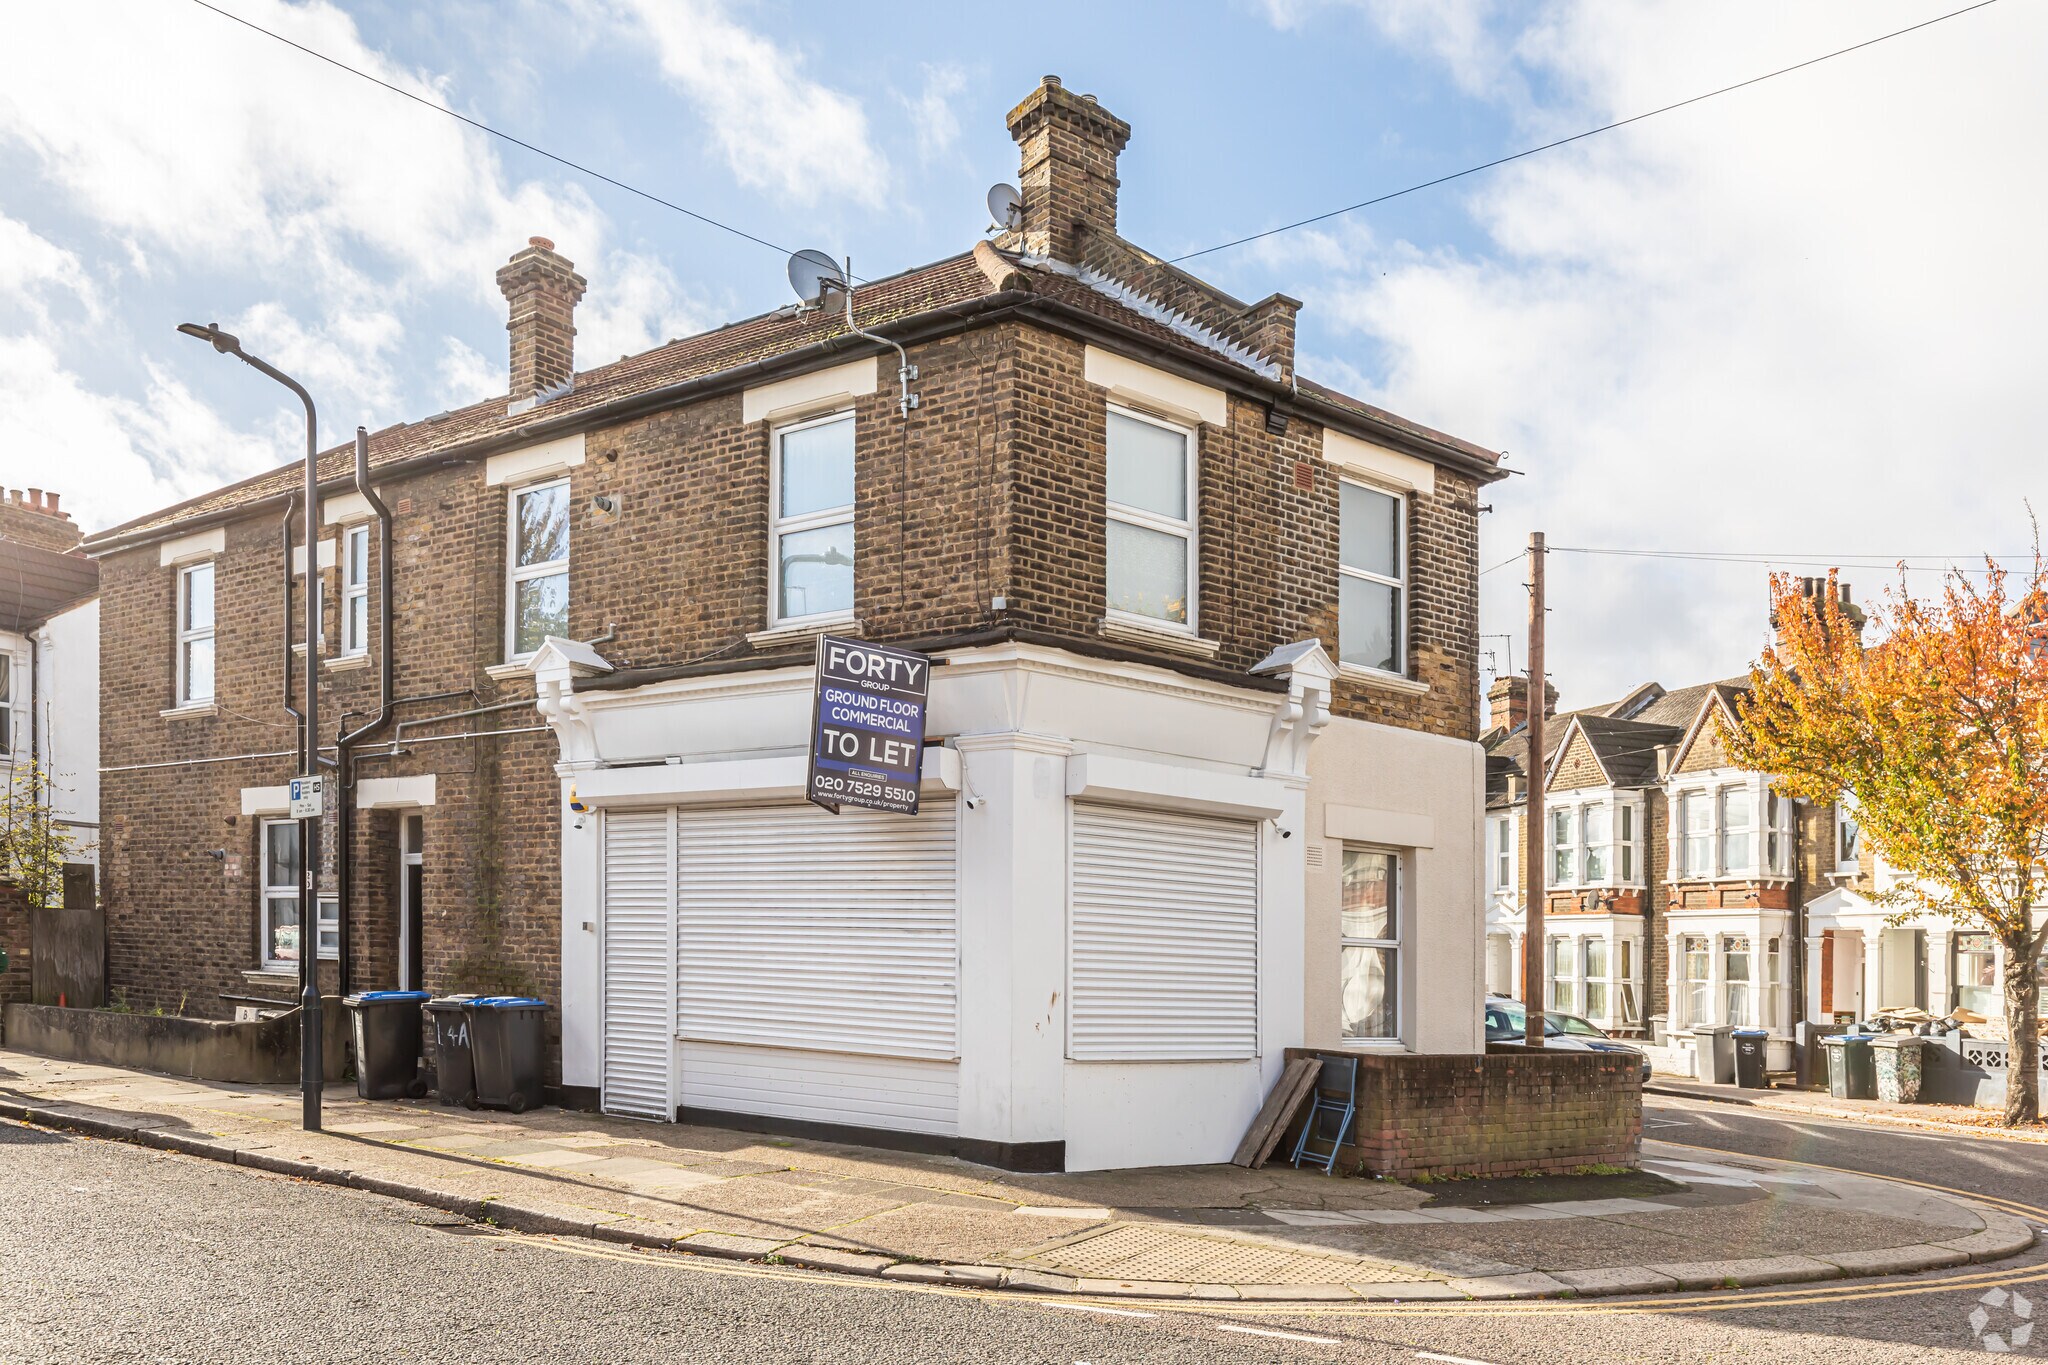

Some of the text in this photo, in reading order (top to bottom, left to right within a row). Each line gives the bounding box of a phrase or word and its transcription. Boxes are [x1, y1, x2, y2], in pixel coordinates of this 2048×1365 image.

[829, 647, 922, 685] FORTY
[860, 679, 890, 691] GROUP
[825, 688, 919, 718] GROUND FLOOR
[831, 706, 911, 733] COMMERCIAL
[824, 728, 916, 767] TO LET
[293, 782, 300, 799] P
[815, 775, 916, 803] 020 7529 5510
[817, 790, 909, 811] www.fortygroup.co.uk/property
